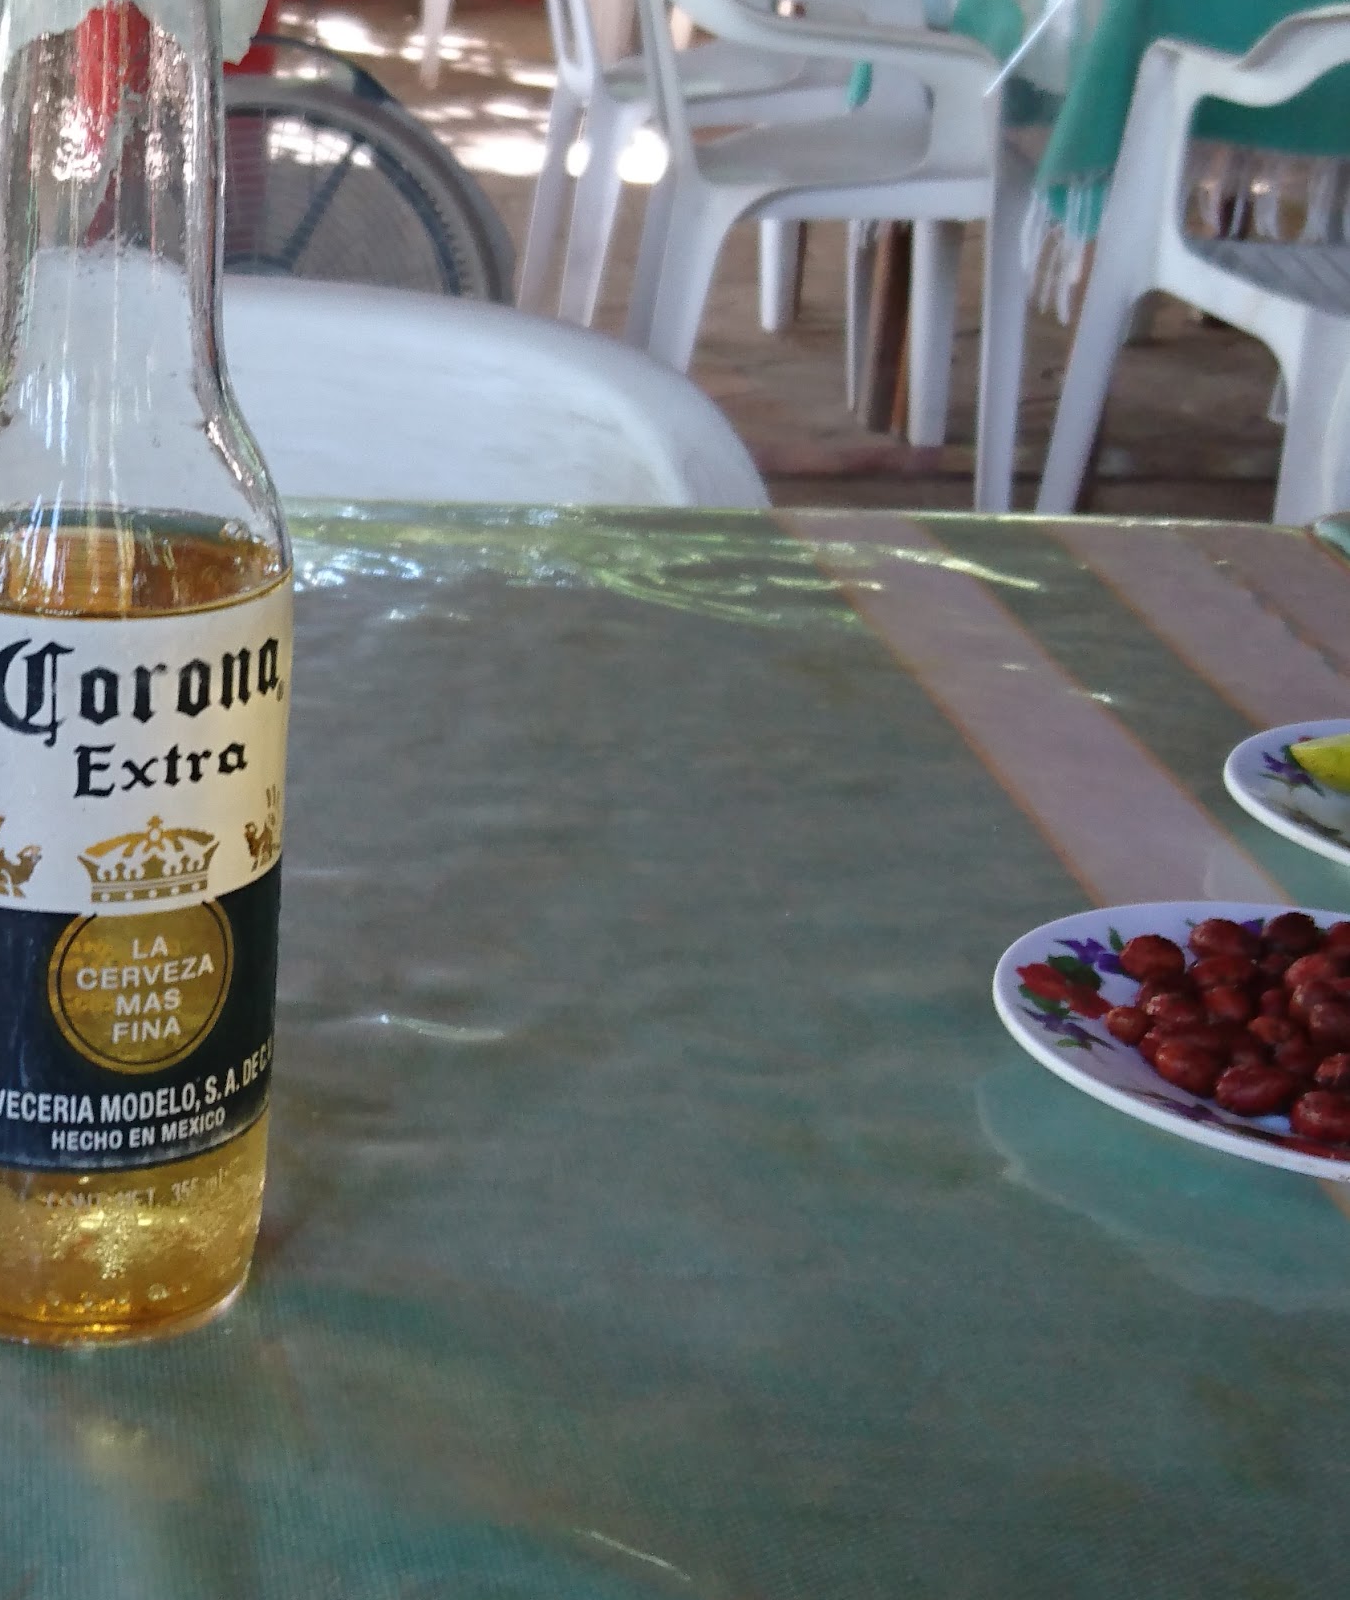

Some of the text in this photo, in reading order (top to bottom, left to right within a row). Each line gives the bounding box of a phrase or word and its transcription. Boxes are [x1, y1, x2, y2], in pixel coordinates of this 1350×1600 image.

[73, 743, 248, 798] Extra
[132, 935, 168, 961] LA
[76, 953, 215, 991] CERVEZA
[115, 987, 181, 1016] MAS
[112, 1015, 181, 1045] FINA
[100, 1081, 201, 1124] MODELO,
[51, 1106, 226, 1151] HECHO EN MEXICO
